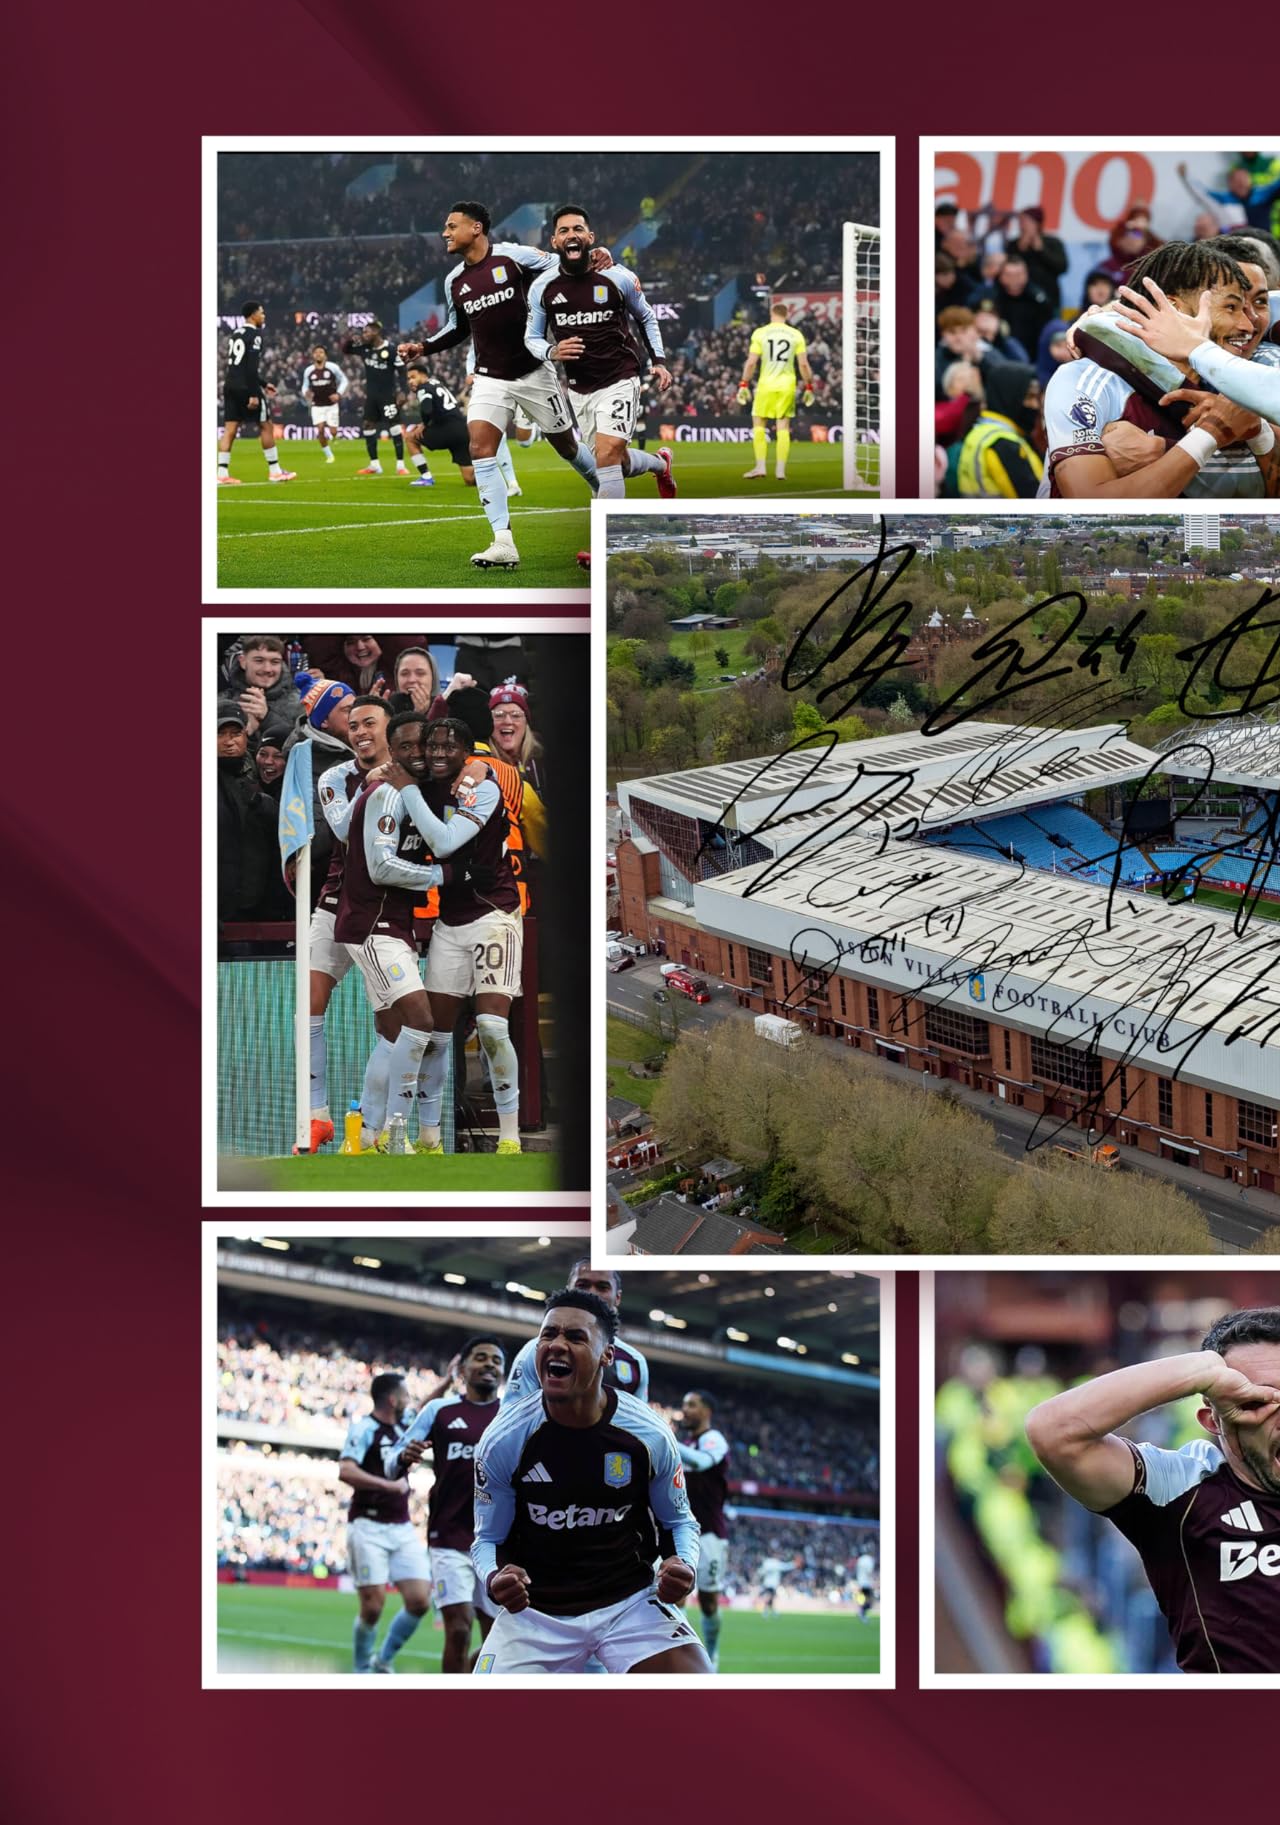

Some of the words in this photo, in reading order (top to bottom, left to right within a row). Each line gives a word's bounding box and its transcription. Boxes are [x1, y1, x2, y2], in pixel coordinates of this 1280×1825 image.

[464, 287, 514, 314] Betano
[555, 309, 614, 326] Betano
[768, 339, 790, 361] 12
[547, 395, 562, 416] 11
[611, 400, 631, 421] 21
[675, 424, 771, 442] GUINNE
[473, 942, 504, 970] 20
[904, 957, 961, 986] VILLA
[994, 984, 1103, 1026] FOOTBALL
[1114, 1019, 1171, 1048] CLUB
[527, 1502, 632, 1530] Betano
